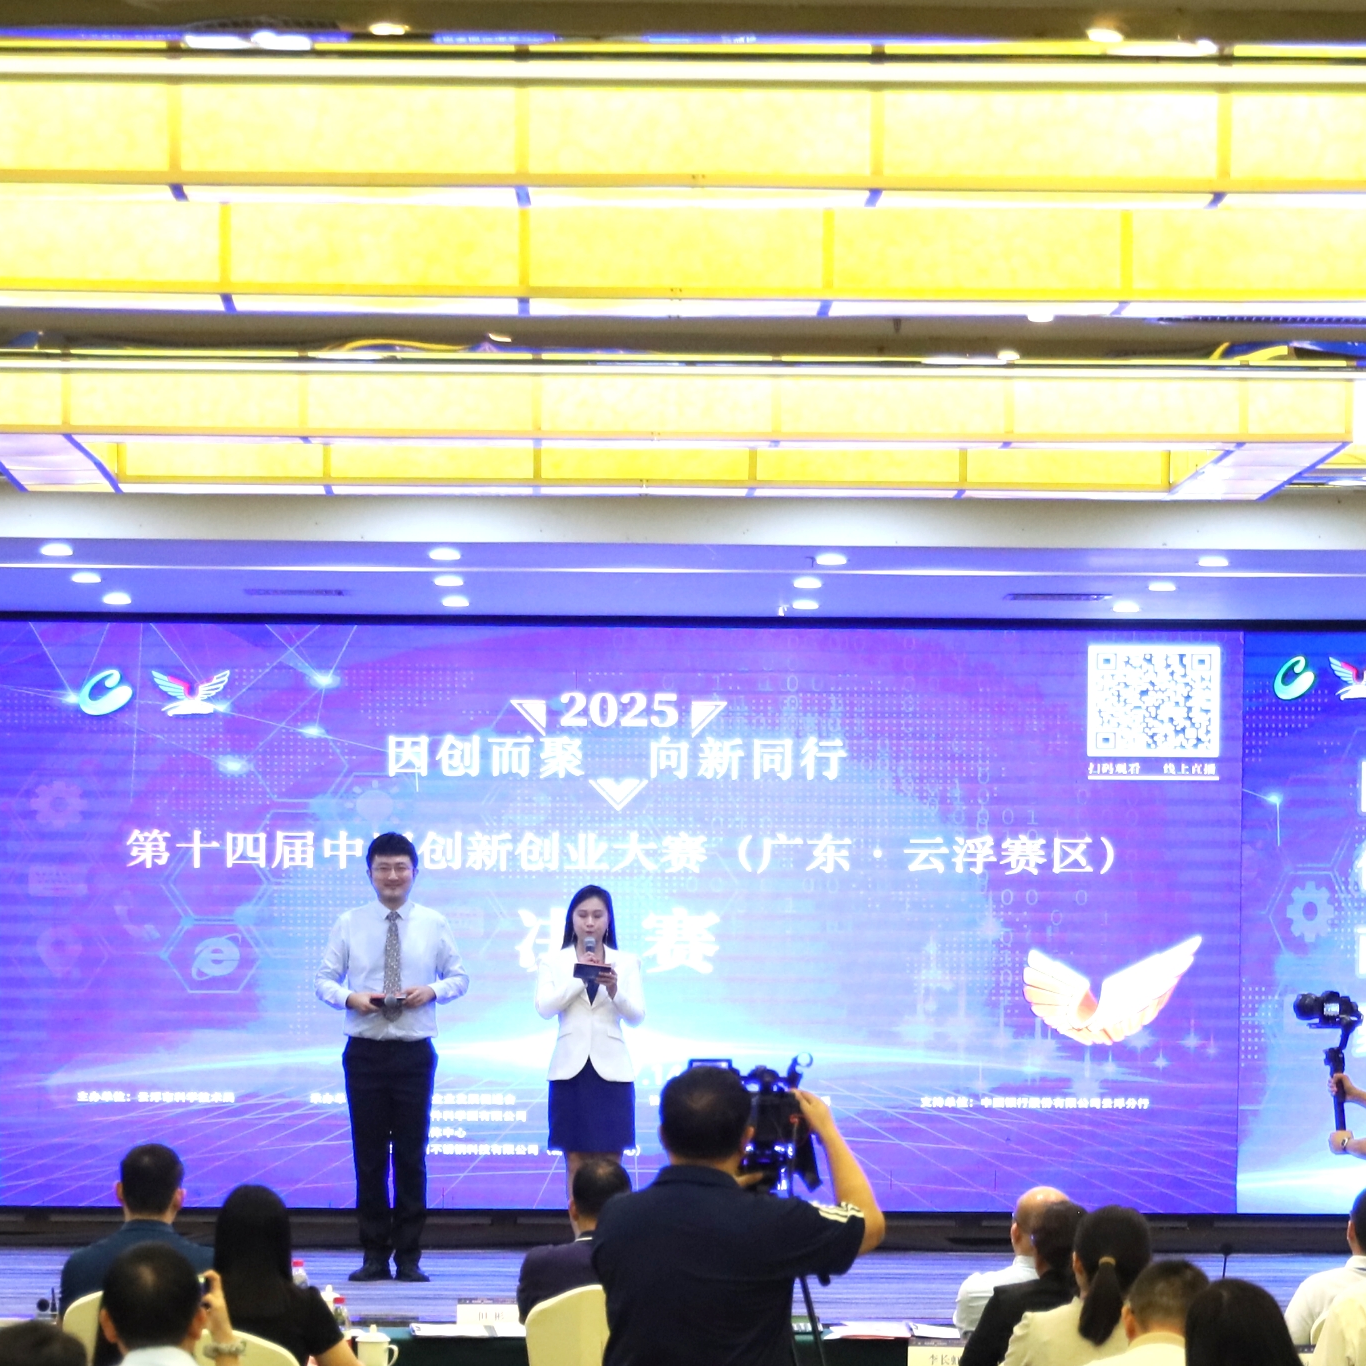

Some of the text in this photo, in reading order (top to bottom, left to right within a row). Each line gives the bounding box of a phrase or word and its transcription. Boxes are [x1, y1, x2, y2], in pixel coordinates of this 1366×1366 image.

[559, 691, 679, 729] 2025
[388, 735, 847, 781] 因创而聚 向新同行
[126, 828, 1116, 875] 第十四届中创新创业大赛（广东·云浮赛区）
